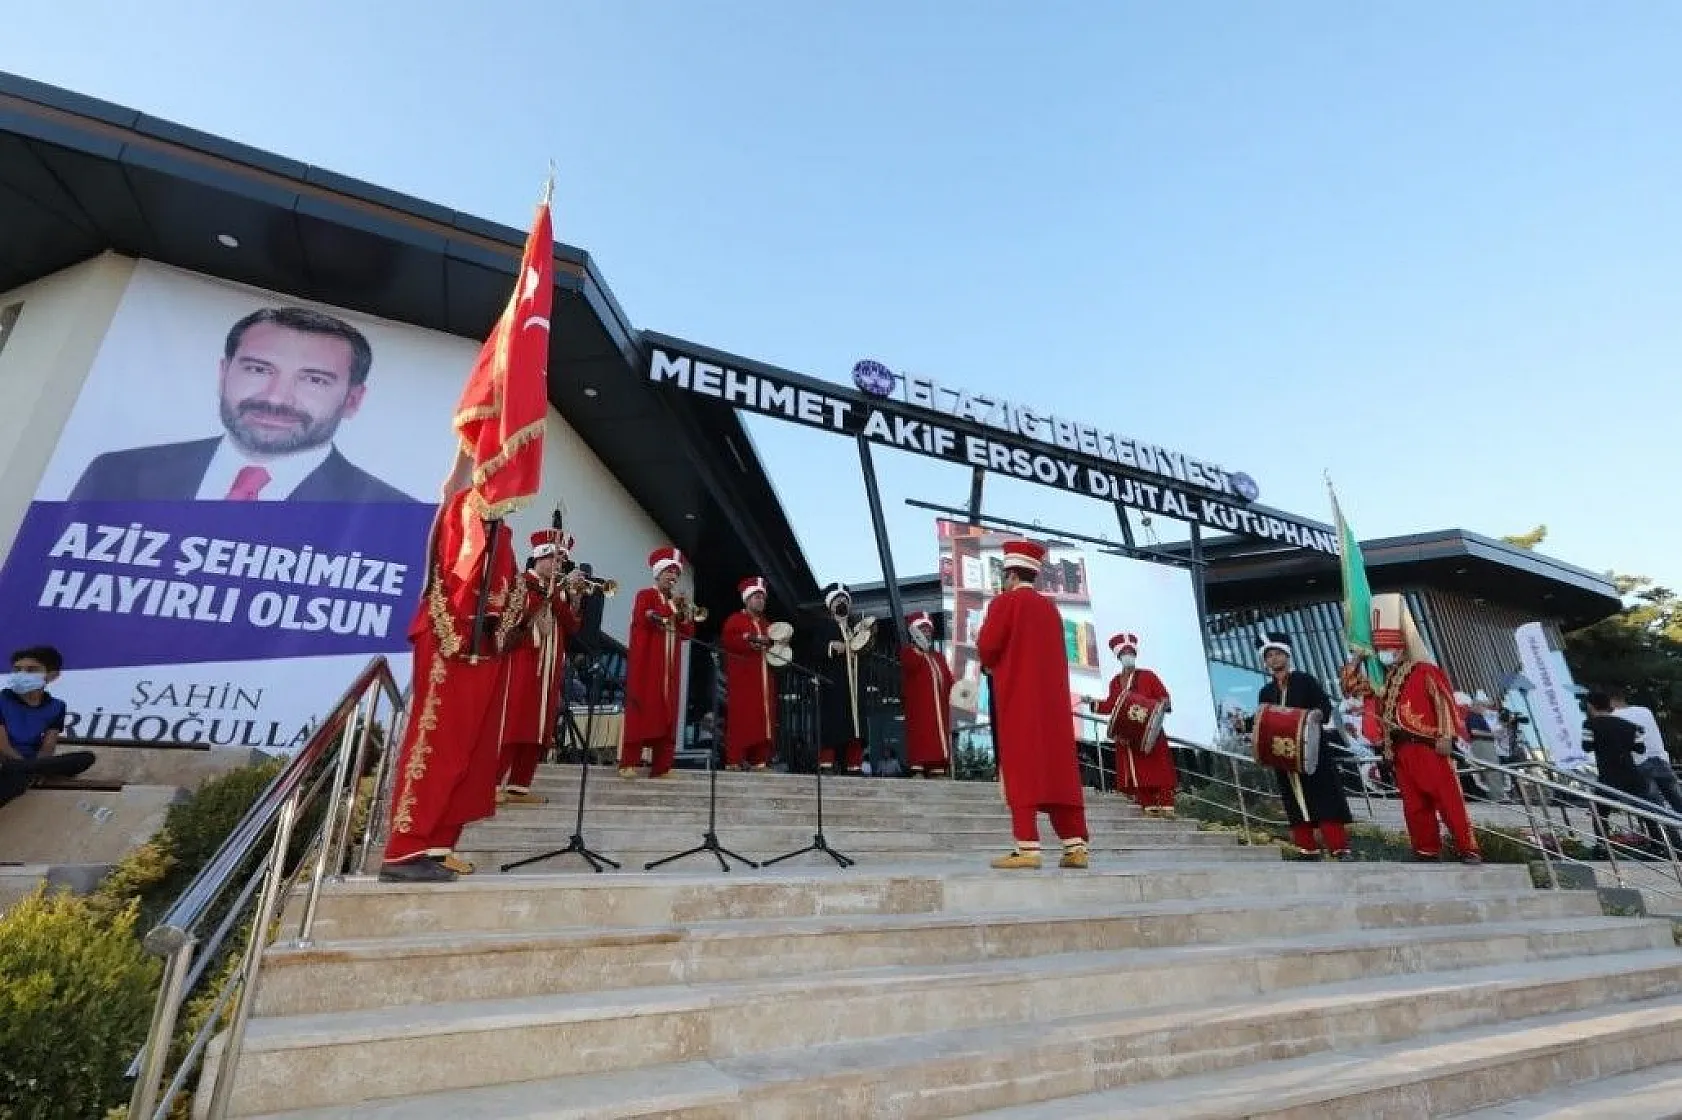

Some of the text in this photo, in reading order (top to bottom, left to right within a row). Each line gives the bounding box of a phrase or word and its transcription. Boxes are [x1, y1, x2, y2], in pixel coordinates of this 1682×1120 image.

[650, 350, 852, 429] MEHMET
[863, 410, 955, 455] AKİF
[965, 435, 1078, 488] ERSOY
[1088, 469, 1198, 518] DİJİTAL
[48, 522, 408, 596] AZİZ ŞEHRİMİZE
[38, 569, 393, 638] HAYIRLI OLSUN
[64, 706, 316, 747] RİFOĞULLA
[130, 680, 264, 711] ŞAHİN
